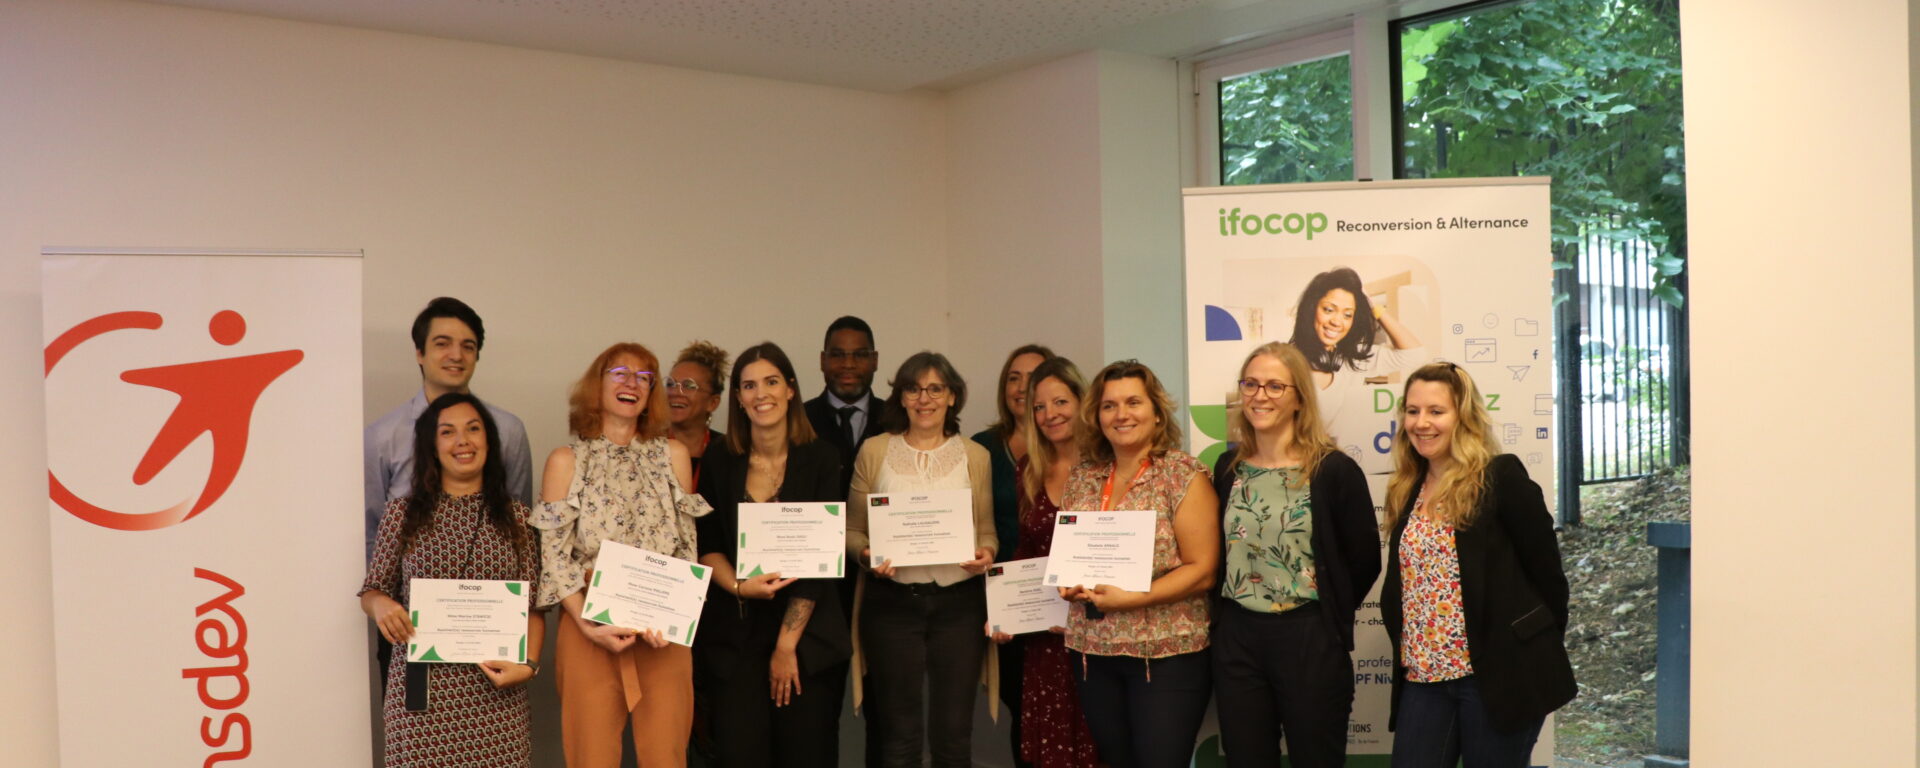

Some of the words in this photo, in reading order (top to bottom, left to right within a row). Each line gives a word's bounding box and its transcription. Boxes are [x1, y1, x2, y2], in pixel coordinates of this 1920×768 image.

[1219, 207, 1328, 240] ifocop
[1336, 218, 1433, 232] Reconversion
[1436, 217, 1446, 230] &
[1449, 216, 1529, 230] Alternance
[645, 555, 668, 566] ifocop
[458, 584, 482, 592] ifocop
